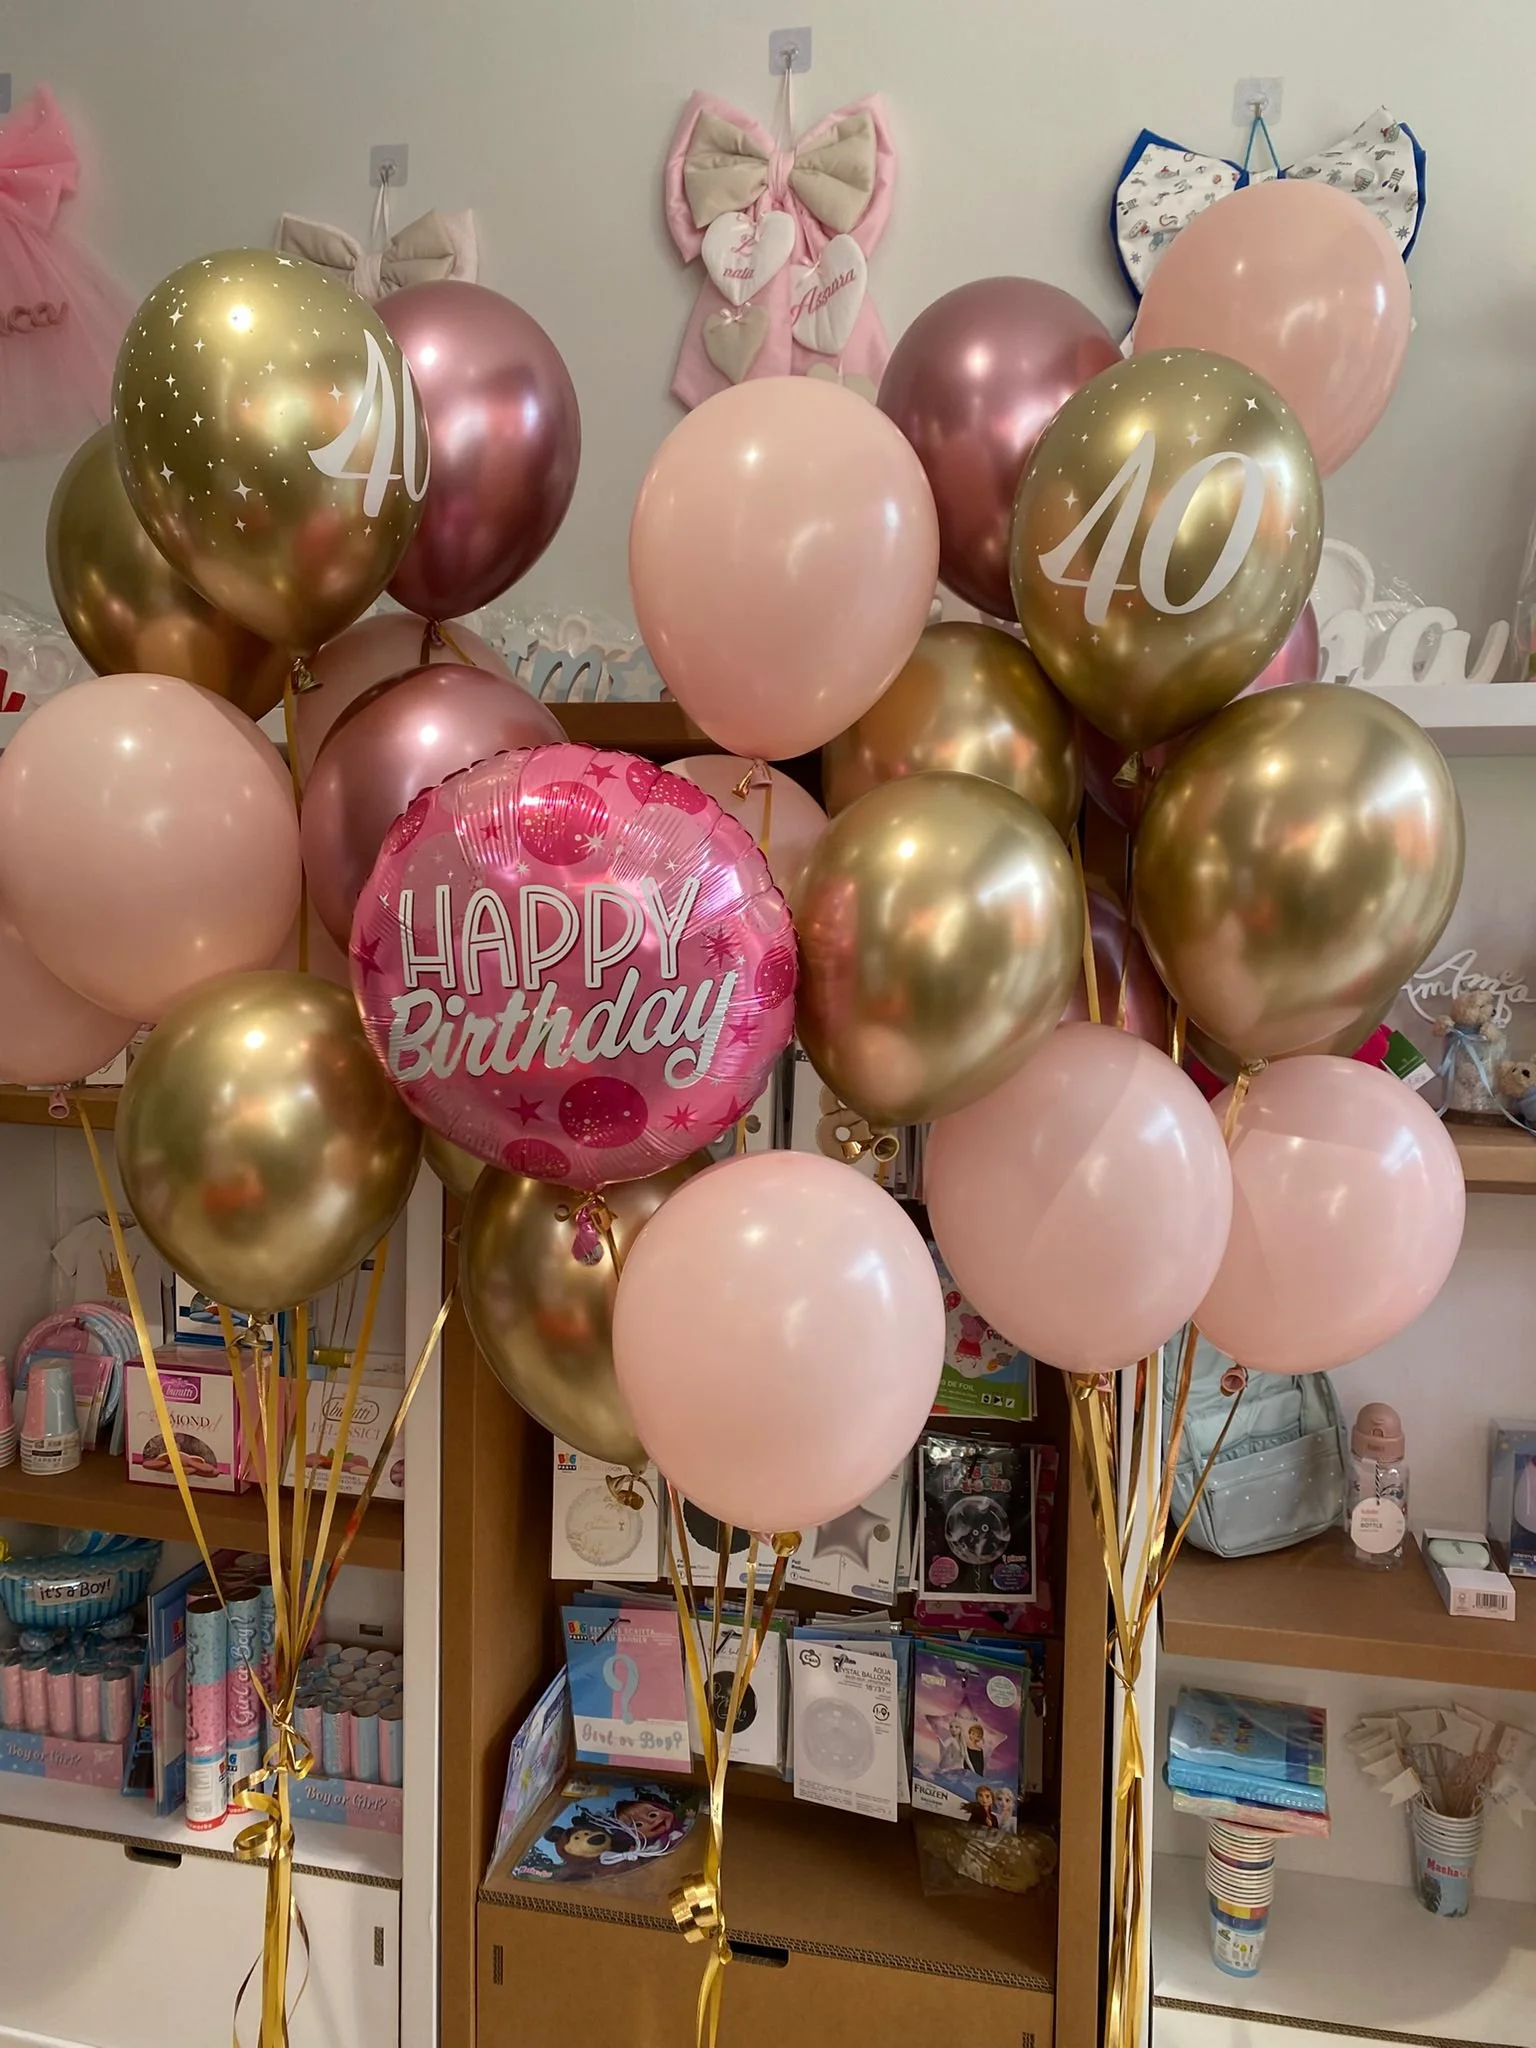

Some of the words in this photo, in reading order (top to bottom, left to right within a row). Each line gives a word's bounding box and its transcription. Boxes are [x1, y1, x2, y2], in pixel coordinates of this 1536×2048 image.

[1038, 430, 1265, 627] 40
[400, 876, 702, 995] HAPPY
[387, 967, 739, 1090] Birthday
[165, 1384, 194, 1399] buratti
[1360, 1522, 1383, 1530] BOTTLE
[67, 1585, 75, 1597] a
[80, 1578, 112, 1598] Boy!
[873, 1667, 892, 1676] AQUA
[230, 1686, 256, 1727] Girl
[305, 1785, 332, 1808] Boy
[333, 1795, 350, 1806] or
[353, 1794, 388, 1812] Girl?
[914, 1784, 949, 1801] FROZEN
[1426, 1857, 1460, 1879] Masha
